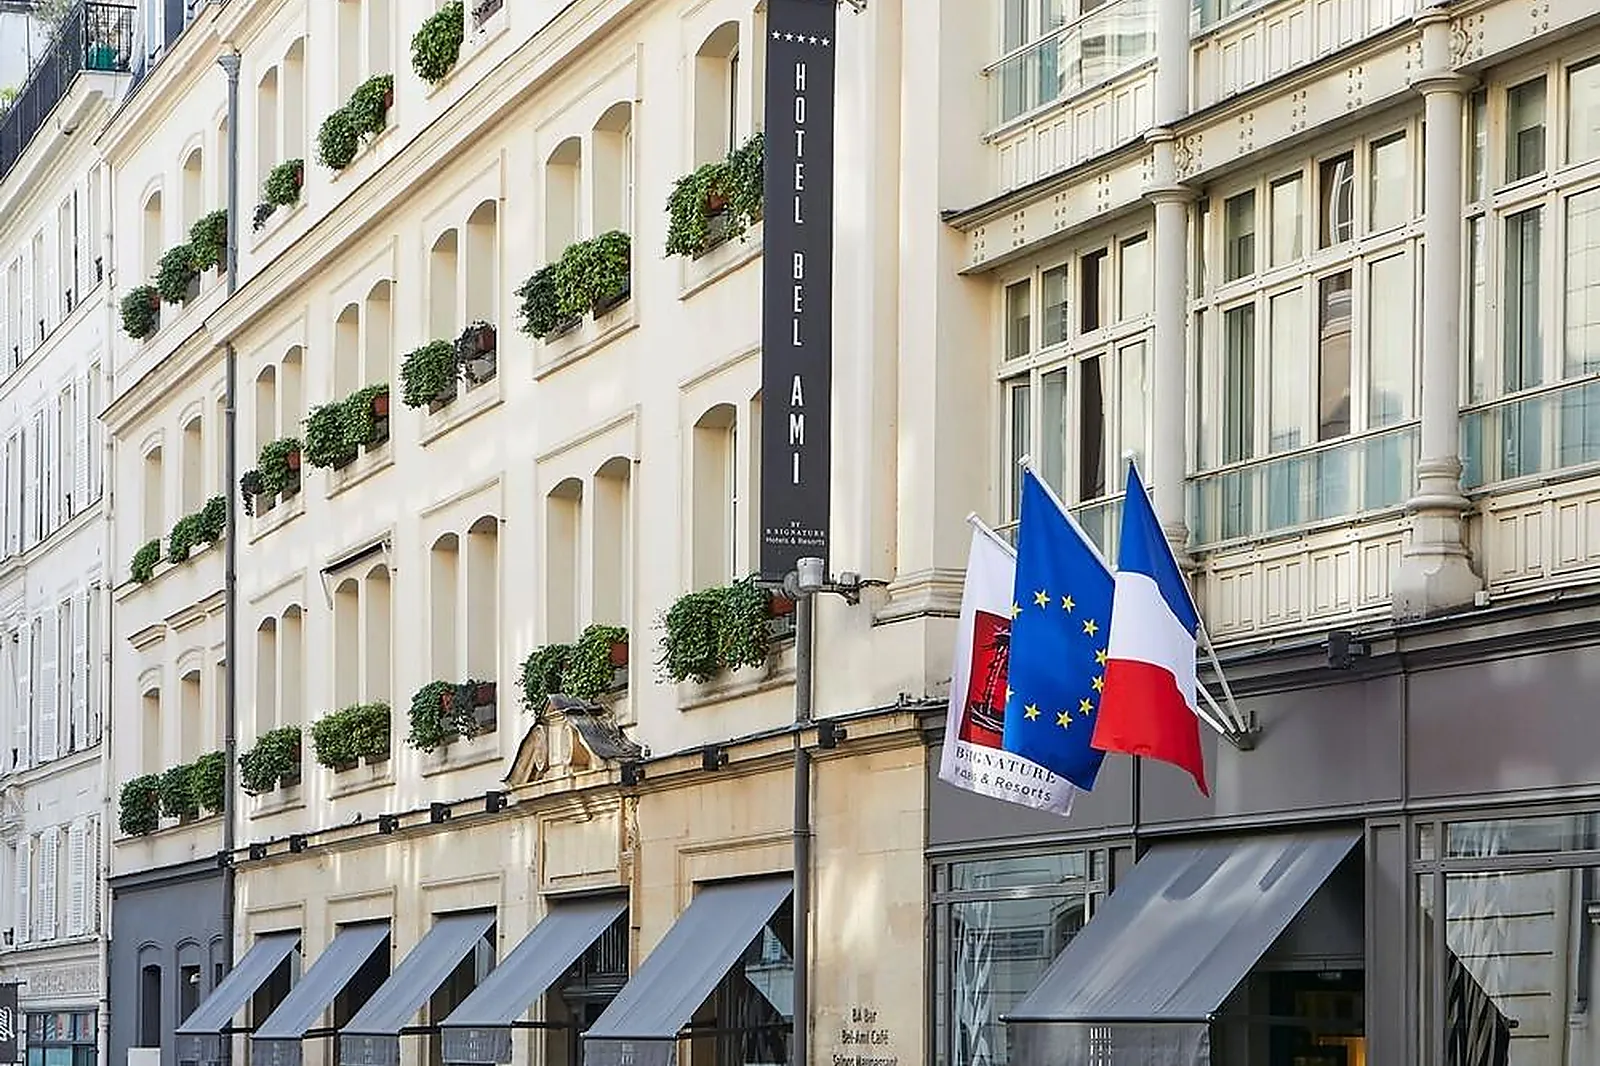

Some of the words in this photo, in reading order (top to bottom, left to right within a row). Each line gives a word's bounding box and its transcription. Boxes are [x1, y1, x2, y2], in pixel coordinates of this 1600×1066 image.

[794, 62, 806, 224] HOTEL
[793, 252, 805, 346] BEL
[789, 375, 805, 485] AMI
[790, 536, 796, 544] &
[798, 537, 825, 545] Resorts
[980, 773, 989, 785] &
[994, 776, 1052, 802] Resorts
[864, 1008, 878, 1023] Bar
